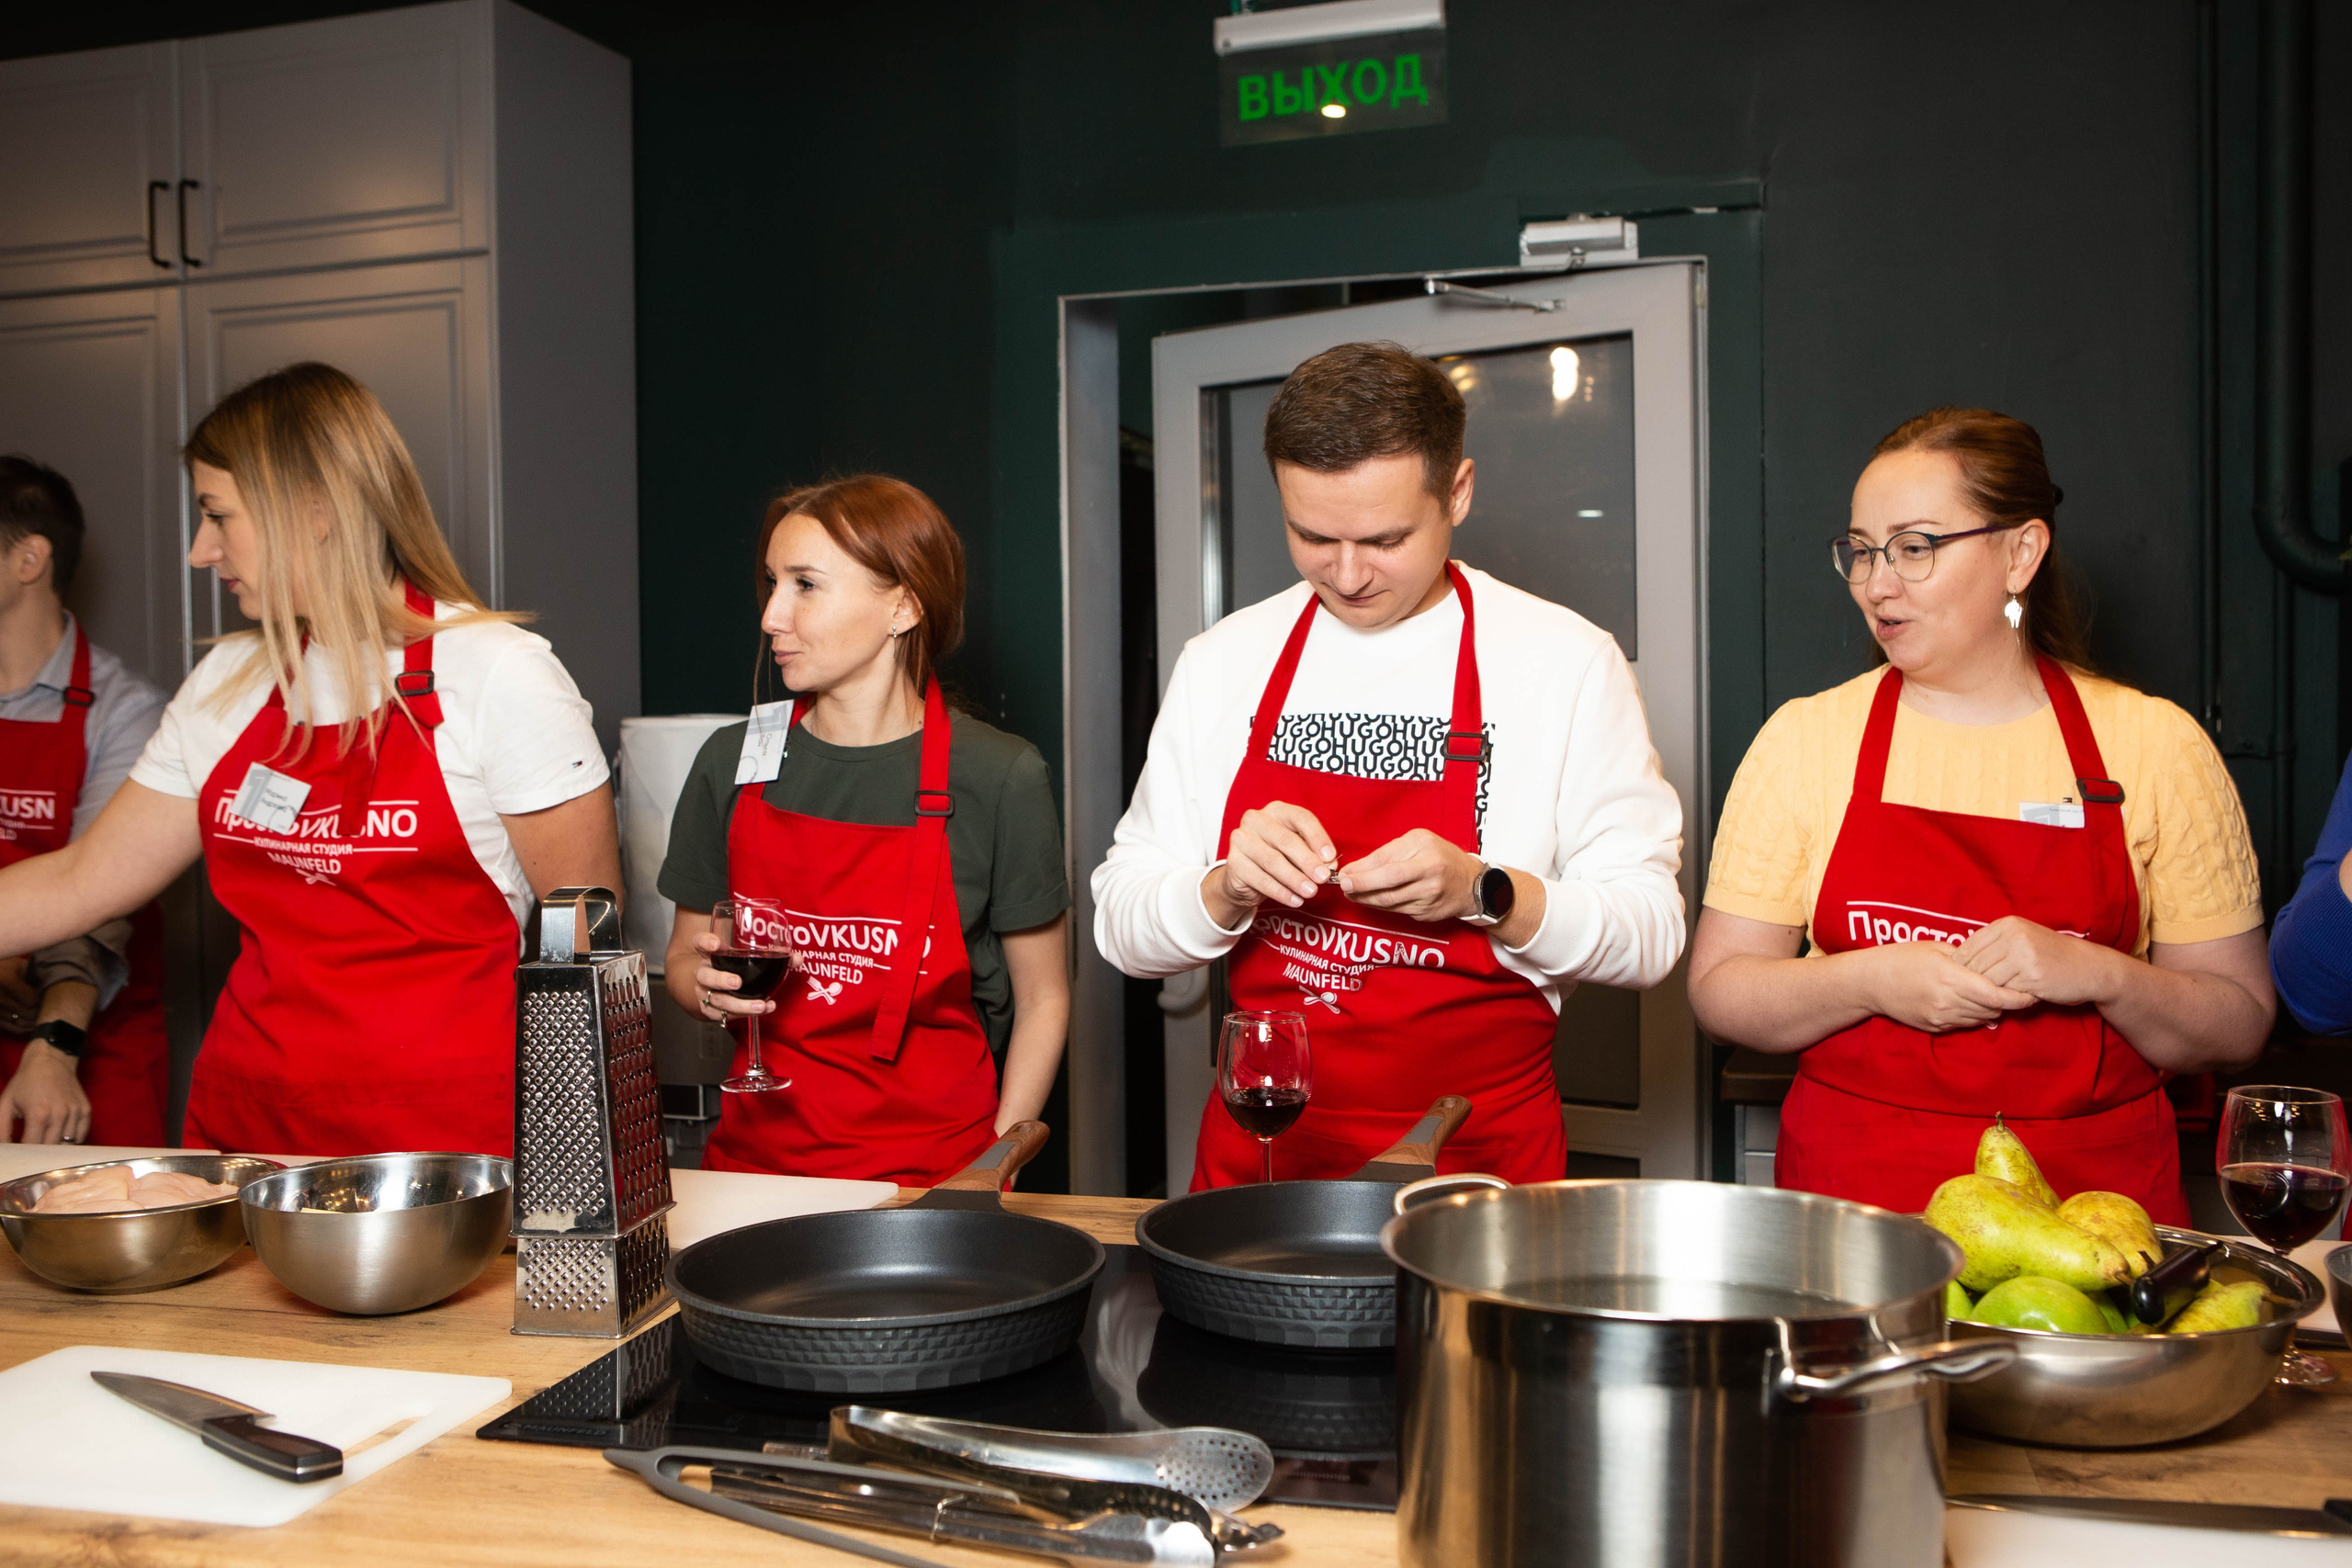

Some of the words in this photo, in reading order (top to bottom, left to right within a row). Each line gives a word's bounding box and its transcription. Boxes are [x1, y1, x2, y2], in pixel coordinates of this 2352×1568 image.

[1238, 53, 1429, 121] ВЫХОД
[266, 851, 342, 874] MAUNFELD
[312, 843, 353, 857] СТУДИЯ
[735, 903, 931, 959] ПростоVKUSN
[1848, 910, 1975, 946] Просто
[790, 961, 864, 985] AUNFELD
[838, 953, 874, 968] СТУДИЯ
[1280, 943, 1329, 971] КУЛИНАРНАЯ
[1329, 962, 1374, 976] СТУДИЯ
[1282, 962, 1363, 992] MAUNFELD
